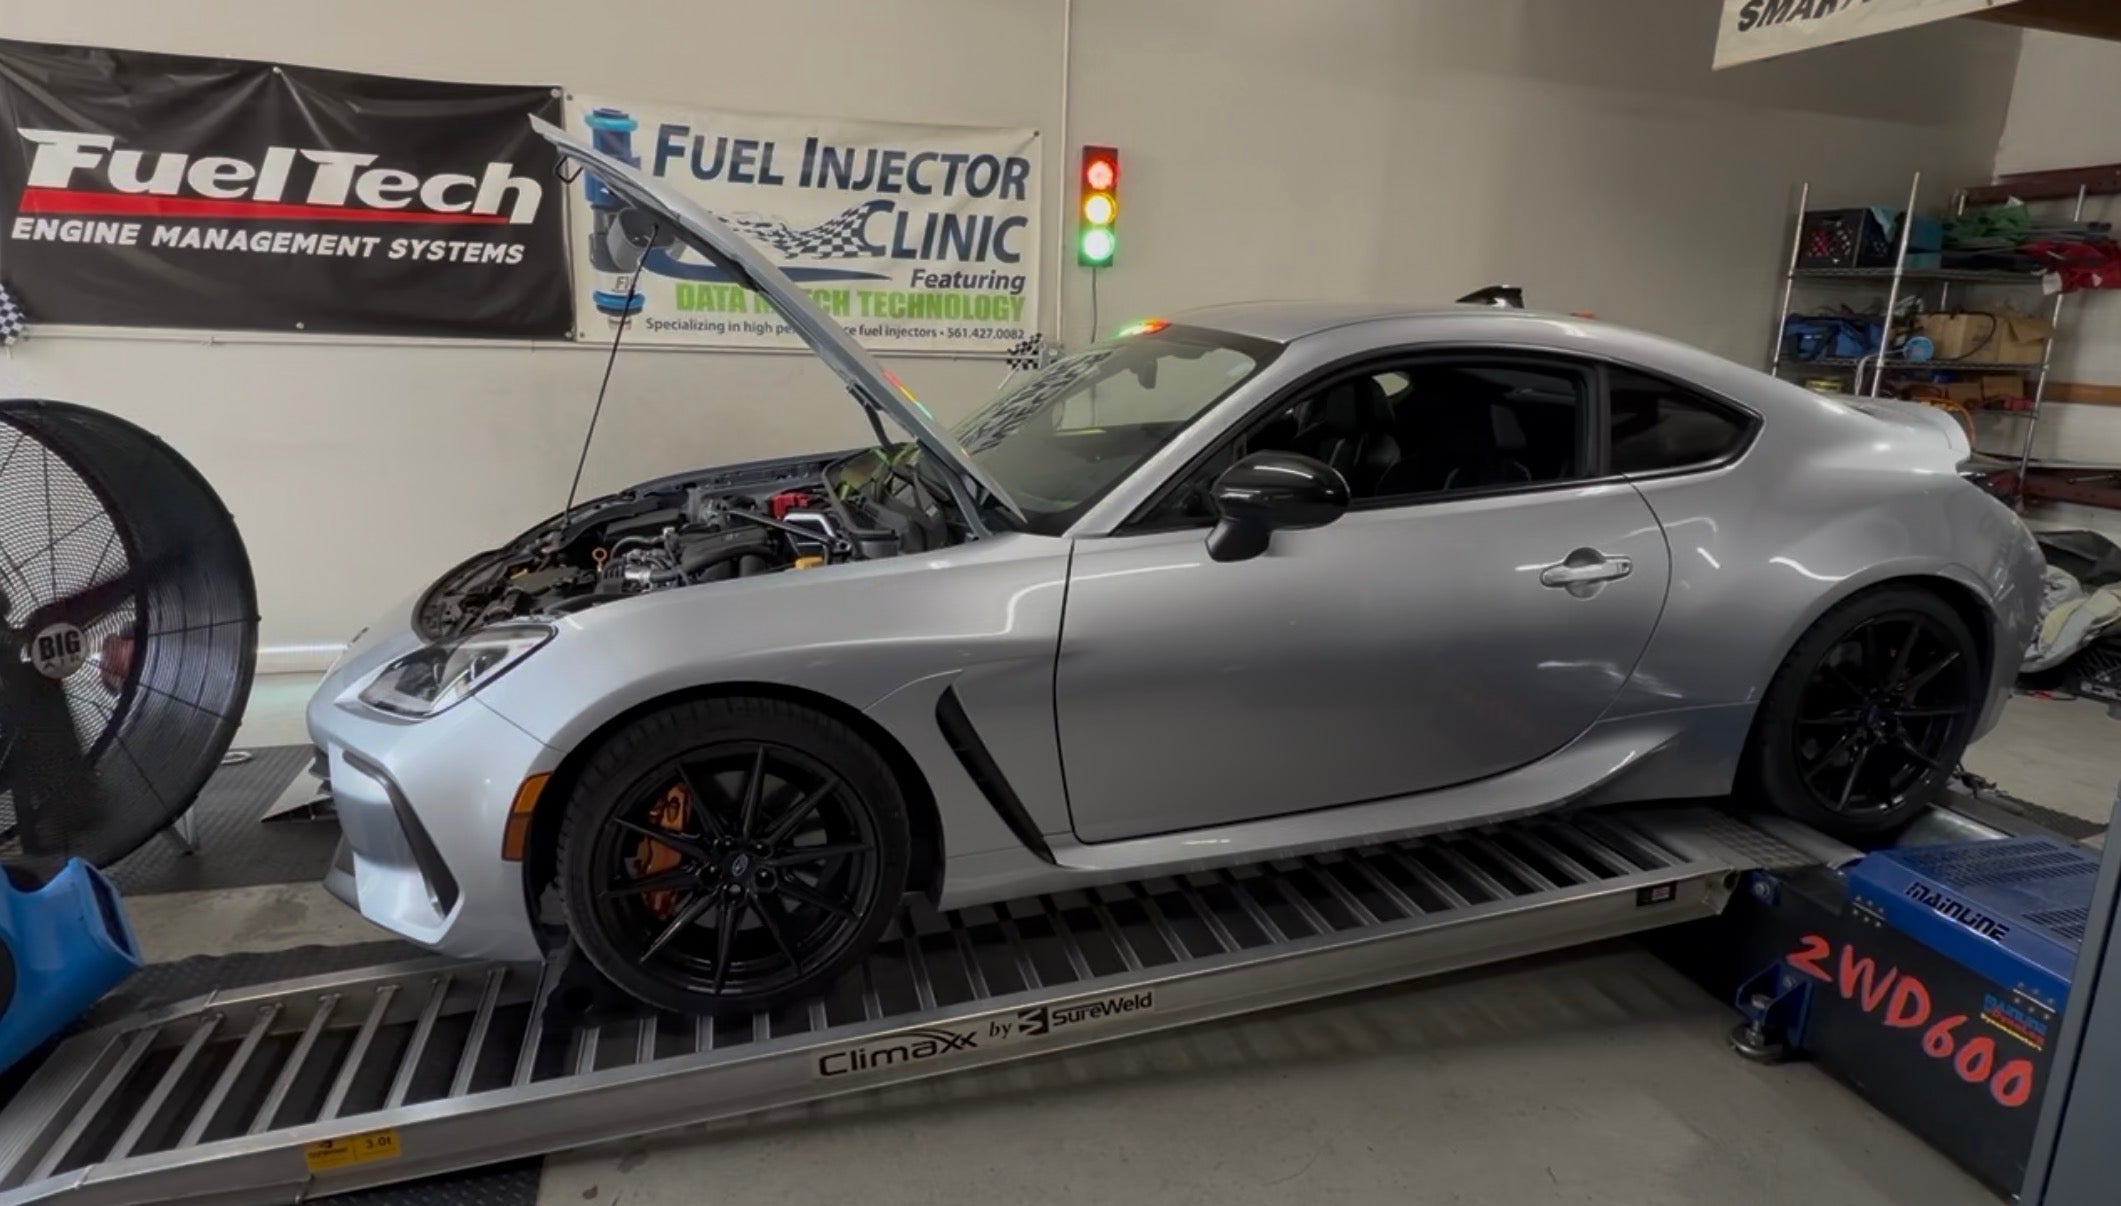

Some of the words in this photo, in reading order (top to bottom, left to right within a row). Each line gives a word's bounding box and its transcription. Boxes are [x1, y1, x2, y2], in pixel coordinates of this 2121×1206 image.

[17, 127, 543, 224] FuelTech
[653, 123, 785, 186] FUEL
[799, 137, 1031, 200] INJECTOR
[11, 217, 140, 245] ENGINE
[151, 226, 380, 259] MANAGEMENT
[388, 238, 525, 265] SYSTEMS
[859, 199, 1028, 264] CLINIC
[675, 282, 747, 313] DATA
[857, 289, 1026, 322] TECHNOLOGY
[910, 268, 1026, 295] Featuring
[646, 317, 726, 333] Specializing
[728, 320, 741, 332] in
[743, 321, 773, 335] high
[859, 325, 882, 337] fuel
[885, 326, 937, 339] injectors
[947, 327, 1025, 340] 561.427.0082
[39, 630, 81, 661] BIG
[819, 1028, 977, 1077] Climaxx
[989, 1021, 1012, 1039] by
[1053, 992, 1153, 1027] SureWeld
[1786, 933, 2034, 1107] 2WD600
